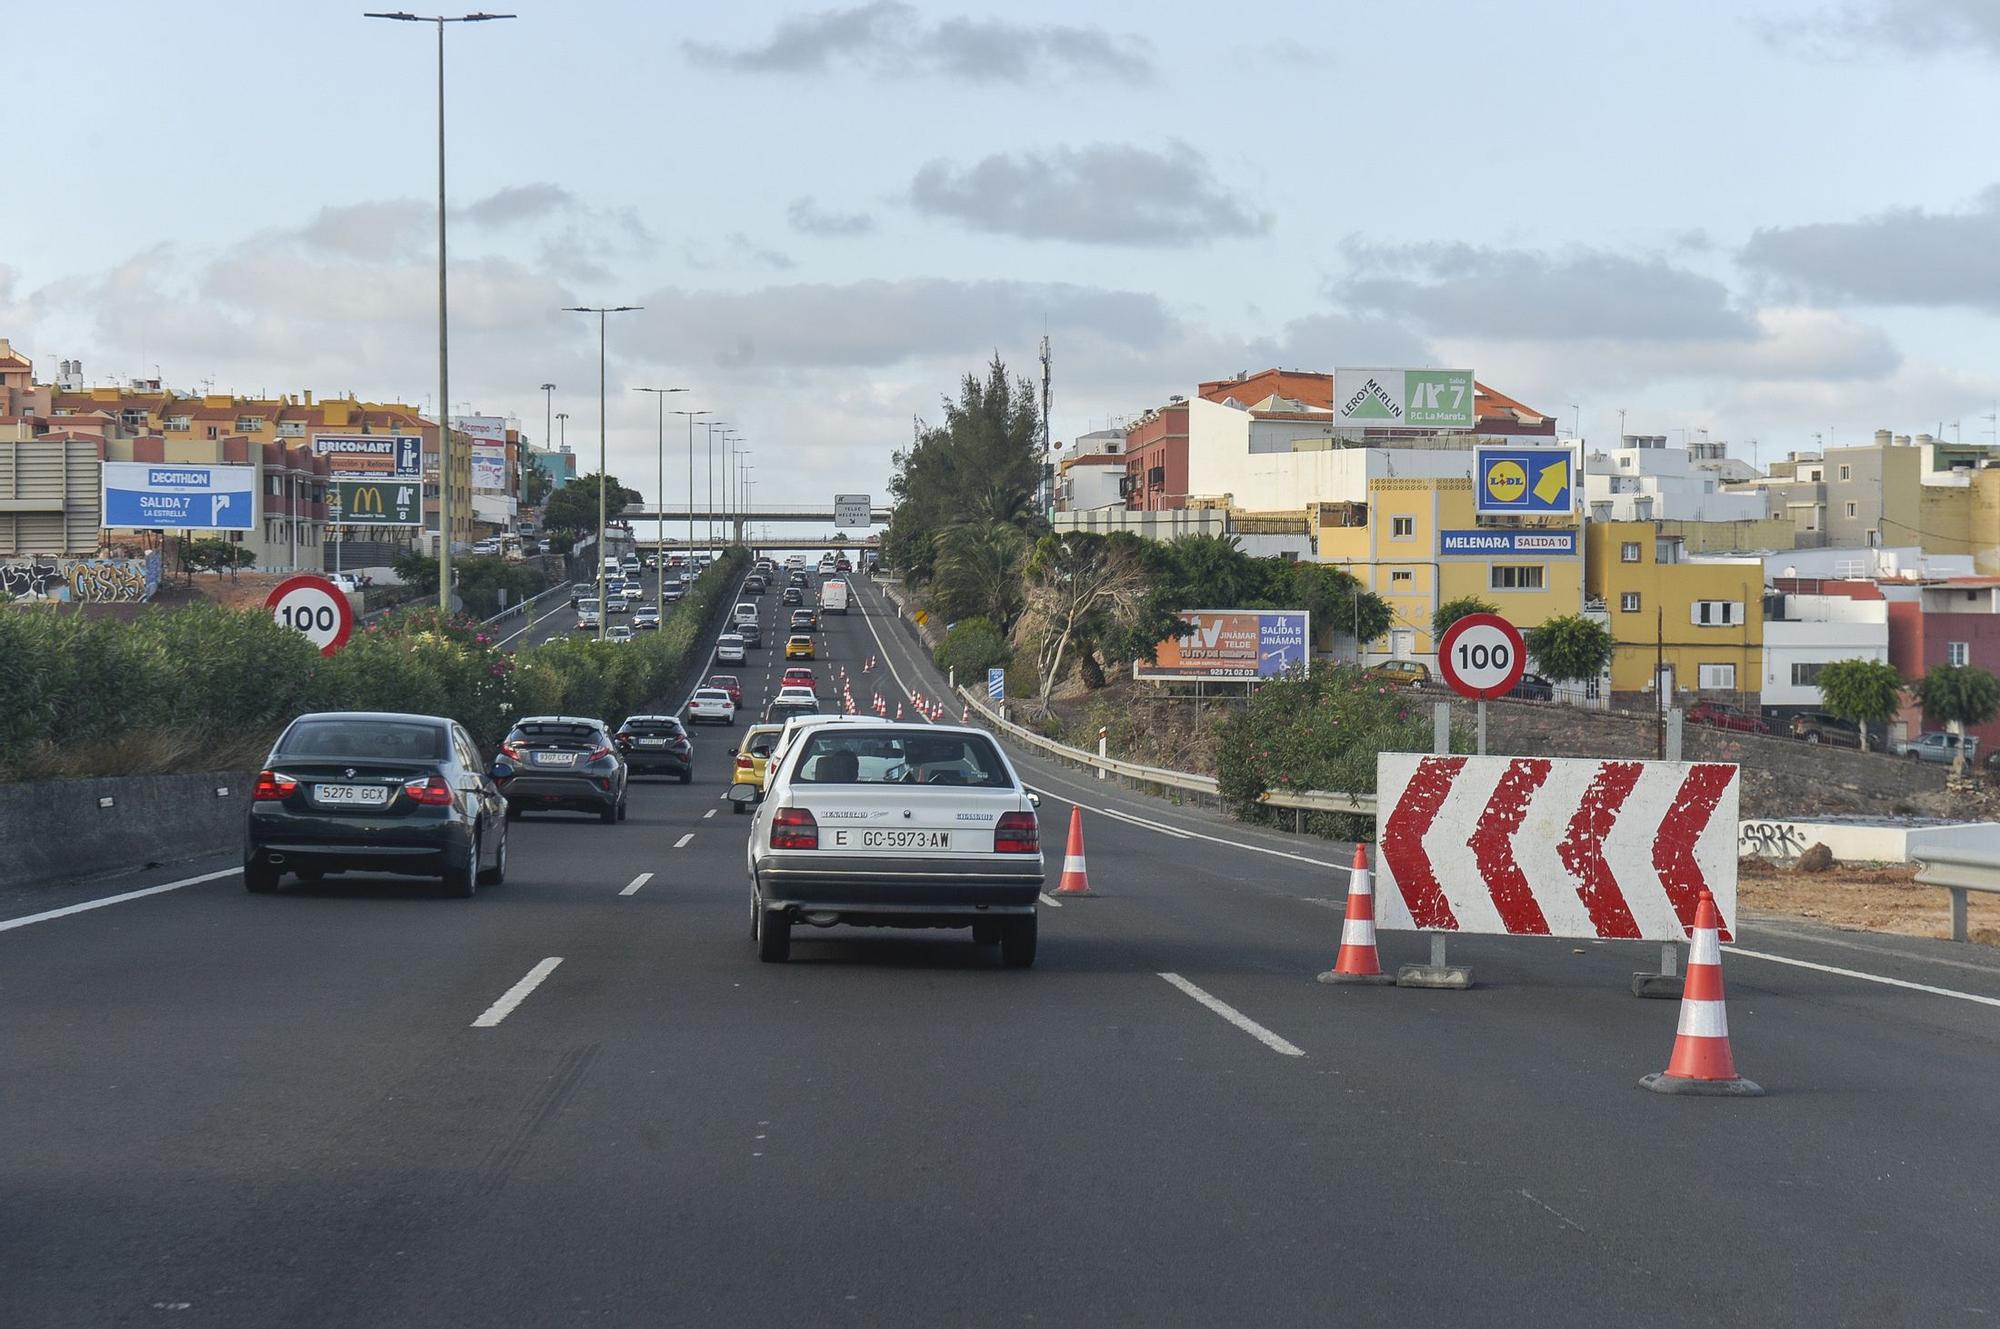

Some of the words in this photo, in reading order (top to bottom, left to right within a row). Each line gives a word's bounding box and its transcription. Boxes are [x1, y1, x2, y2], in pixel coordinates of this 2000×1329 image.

[1340, 385, 1370, 417] LEROY
[1366, 378, 1403, 418] MERLIN
[1449, 385, 1466, 409] 7
[1425, 411, 1436, 420] La
[318, 440, 392, 454] BRICOMART
[403, 438, 413, 449] 5
[151, 471, 208, 485] DECATHLON
[139, 496, 181, 509] SALIDA
[183, 497, 191, 509] 7
[143, 509, 153, 517] LA
[154, 510, 187, 518] ESTRELLA
[399, 511, 407, 520] 8
[1445, 536, 1510, 549] MELENARA
[1517, 538, 1555, 547] SALIDA
[1558, 537, 1568, 547] 10
[282, 605, 335, 632] 100
[1261, 626, 1294, 635] SALIDA
[1225, 641, 1251, 649] TELDE
[1261, 636, 1302, 646] JINÁMAR
[1180, 650, 1192, 659] TU
[1458, 643, 1509, 670] 100
[1224, 668, 1233, 676] 71
[1233, 668, 1244, 676] 02
[1244, 668, 1254, 676] 03
[323, 786, 354, 799] 5276
[361, 788, 385, 800] GCX
[835, 830, 848, 846] E
